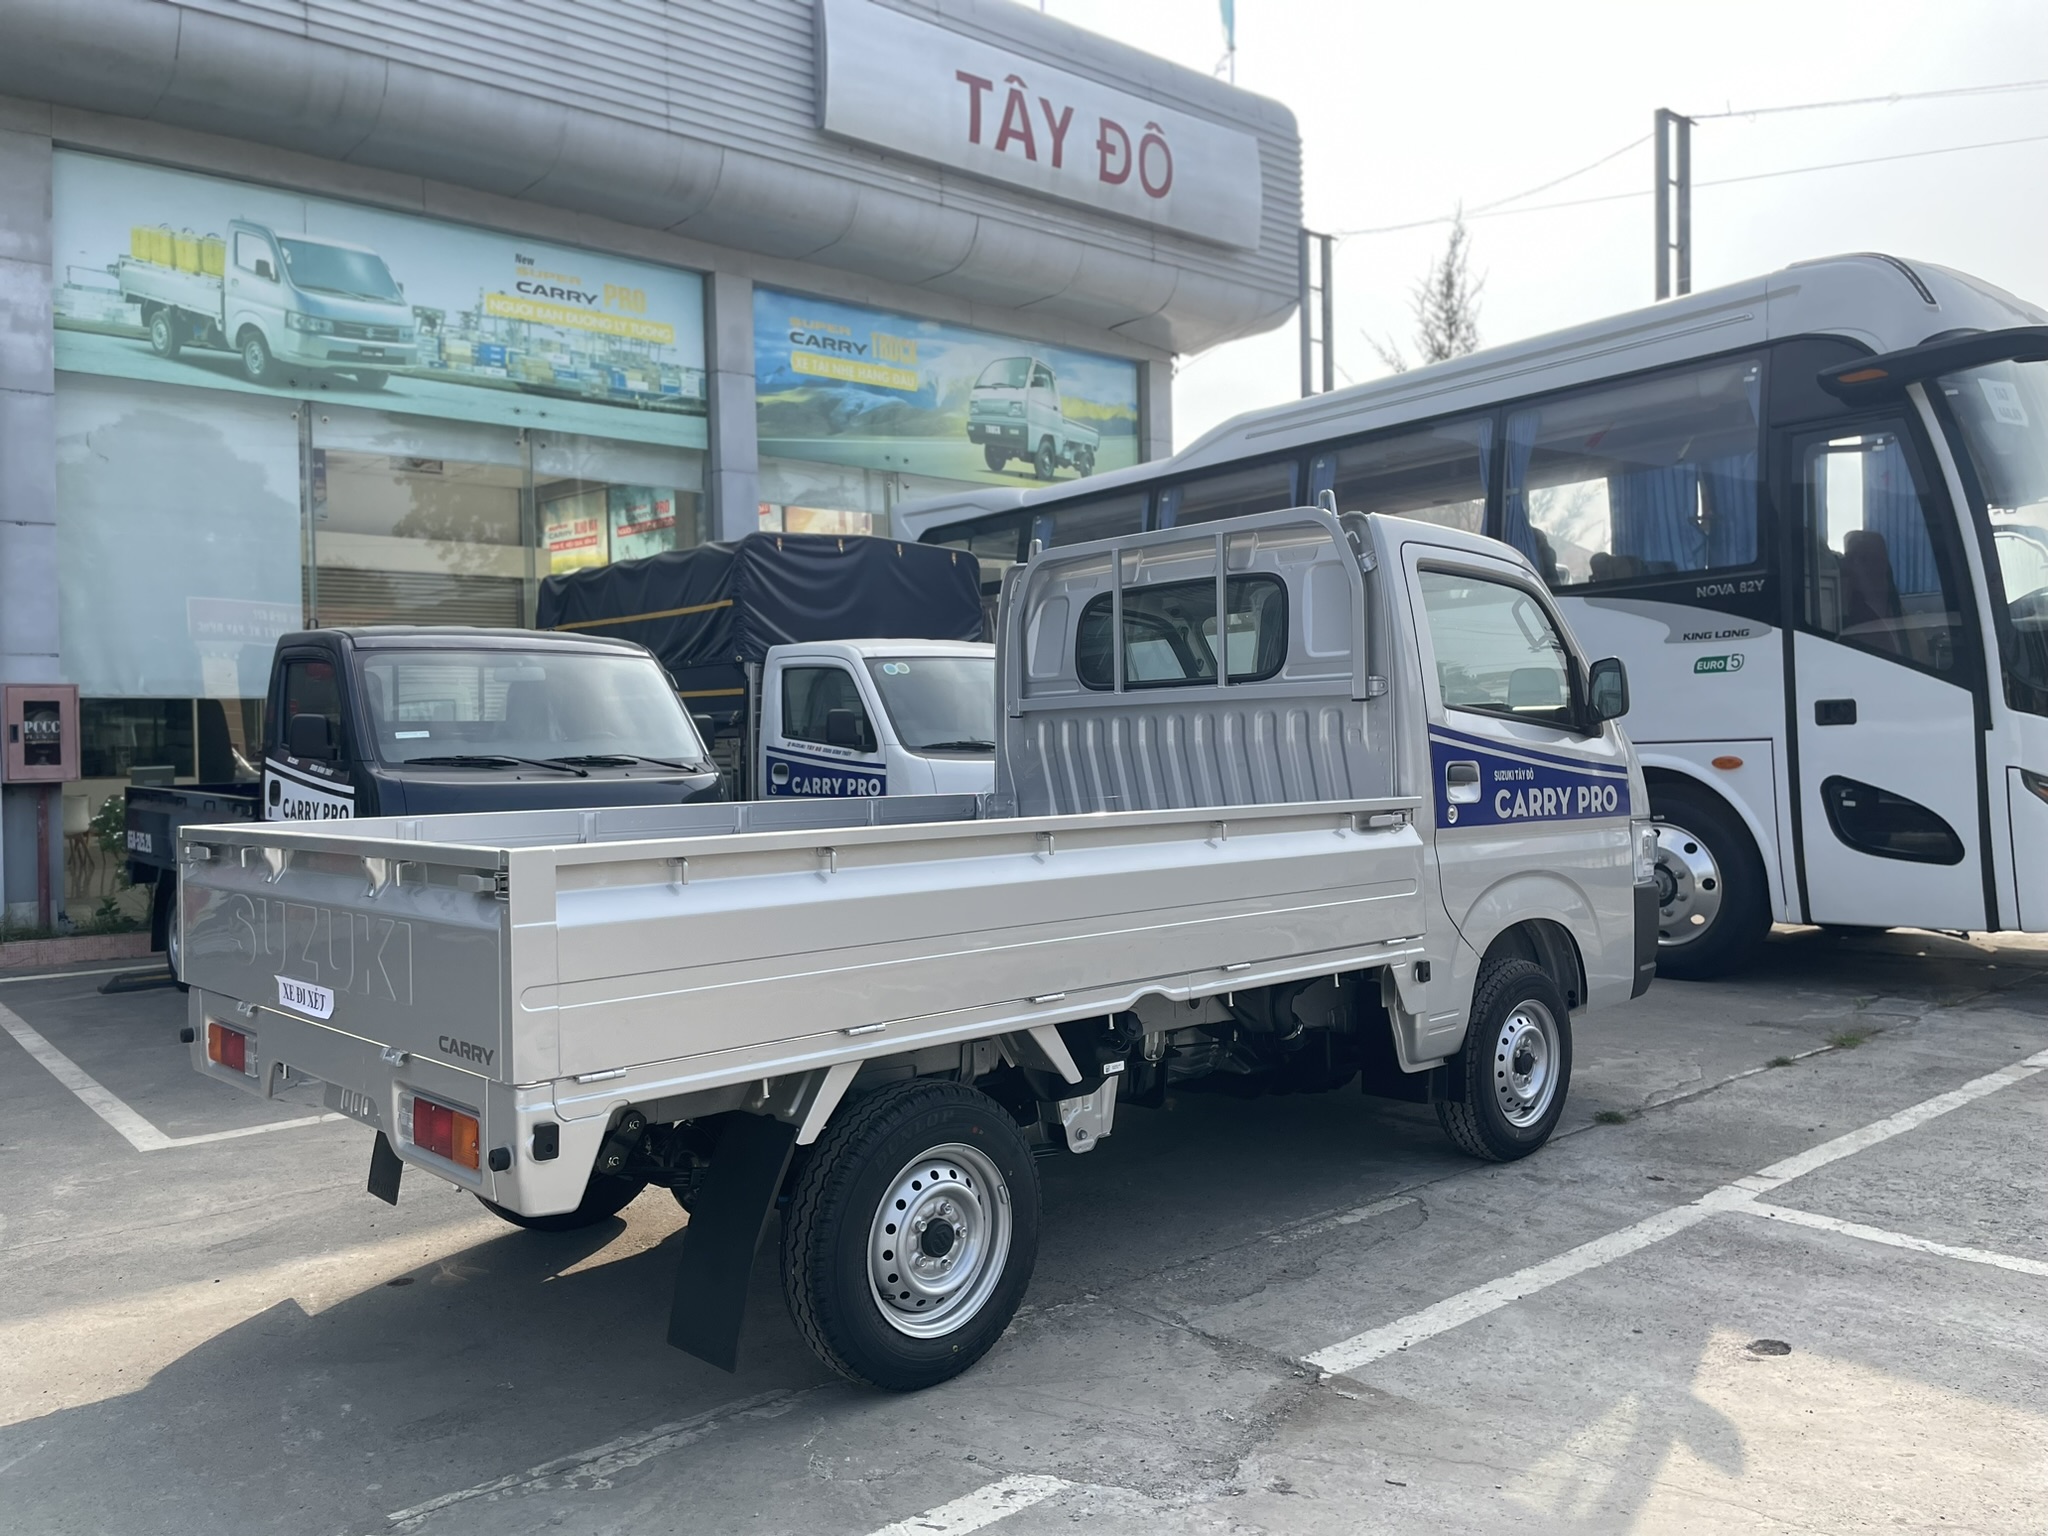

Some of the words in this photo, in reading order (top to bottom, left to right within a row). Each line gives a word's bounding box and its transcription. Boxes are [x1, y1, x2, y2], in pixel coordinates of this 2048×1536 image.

[955, 69, 1075, 169] TÂY
[1096, 117, 1173, 199] ĐÔ
[514, 253, 535, 266] New
[516, 267, 582, 286] SUPER
[516, 281, 599, 305] CARRY
[603, 283, 648, 314] PRO
[789, 317, 852, 336] SUPER
[789, 331, 868, 355] CARRY
[871, 332, 918, 366] TRUCK
[1696, 583, 1736, 599] NOVA
[1739, 579, 1766, 594] 82Y
[1682, 631, 1713, 641] KING
[1714, 628, 1750, 639] LONG
[1696, 660, 1725, 671] EURO
[1730, 653, 1741, 669] 5
[23, 720, 60, 734] PCCC
[1493, 769, 1515, 782] SUZUKI
[1514, 766, 1526, 780] TÂY
[1525, 766, 1535, 781] ĐÔ
[791, 777, 843, 795] CARRY
[846, 778, 881, 796] PRO
[282, 798, 320, 820] CARRY
[323, 803, 349, 820] PRO
[1494, 786, 1572, 819] CARRY
[1577, 784, 1618, 814] PRO
[229, 893, 414, 1006] SUZUKI
[282, 982, 295, 1002] XE
[296, 985, 306, 1006] ĐI
[438, 1035, 495, 1066] CARRY
